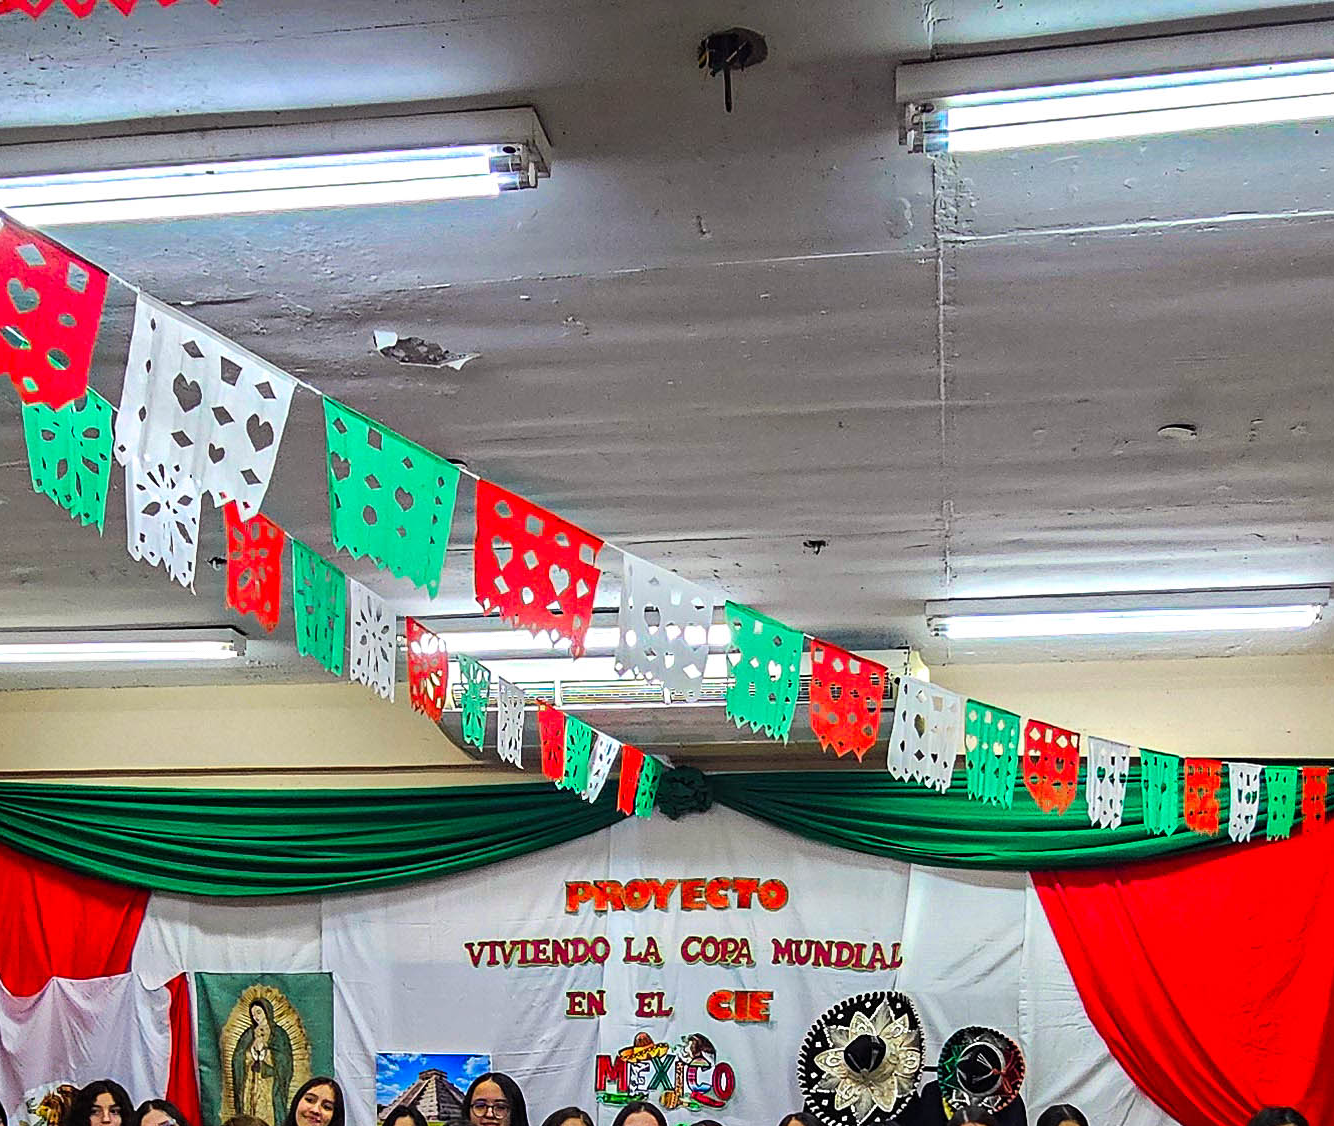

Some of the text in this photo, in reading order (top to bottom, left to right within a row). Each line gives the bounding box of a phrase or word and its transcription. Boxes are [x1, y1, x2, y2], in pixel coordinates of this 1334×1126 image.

[564, 877, 789, 915] PROYECTO
[464, 935, 903, 972] VIVIENDO LA COPA MUNDIAL
[565, 989, 774, 1023] EN EL CIE
